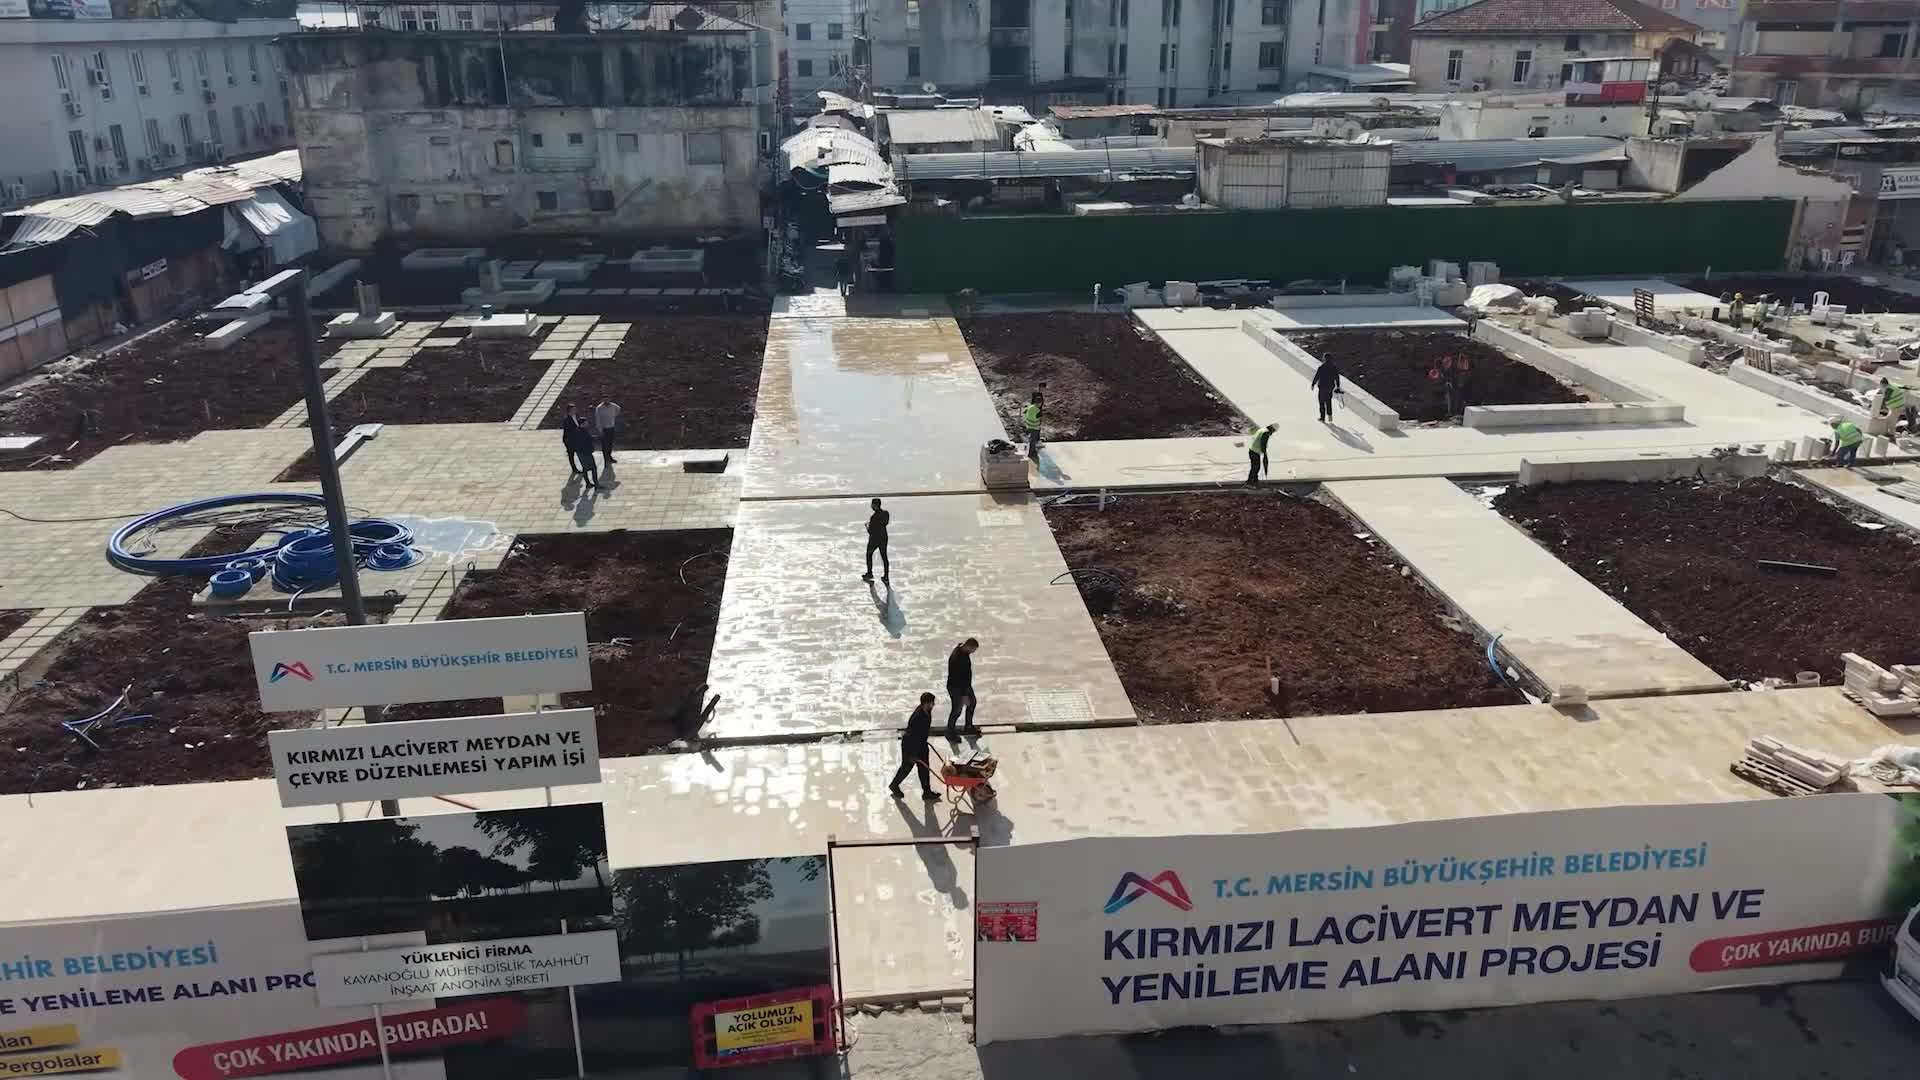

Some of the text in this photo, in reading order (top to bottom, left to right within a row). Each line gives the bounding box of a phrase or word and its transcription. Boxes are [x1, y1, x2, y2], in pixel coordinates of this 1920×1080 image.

[325, 646, 578, 675] T.C. MERSİN BÜYÜKŞEHİR BELEDİYESİ
[287, 731, 581, 765] KIRMIZI LACİVERT MEYDAN VE
[288, 748, 586, 788] ÇEVRE DÜZENLEMESİ YAPIM İŞİ
[1213, 842, 1708, 898] T.C. MERSİN BÜYÜKŞEHİR BELEDİYESİ
[1103, 889, 1765, 961] KIRMIZI LACİVERT MEYDAN VE
[63, 939, 218, 976] BELEDİYESİ
[401, 943, 533, 965] YÜKLENİCİ FİRMA
[1721, 942, 1761, 967] ÇOK
[1768, 931, 1850, 957] YAKINDA
[343, 954, 592, 985] KAYANOĞLU MÜHENDİSLİK TAAHHÜT
[390, 981, 436, 998] İNŞAAT
[441, 975, 501, 991] ANONİM
[1101, 932, 1663, 1005] YENİLEME ALANI PROJESİ
[23, 986, 165, 1012] YENİLEME
[173, 976, 257, 1000] ALANI
[734, 1006, 795, 1022] YOLUMUZ
[760, 1014, 803, 1029] OLSUN
[213, 1011, 489, 1075] ÇOK YAKINDA BURADA!
